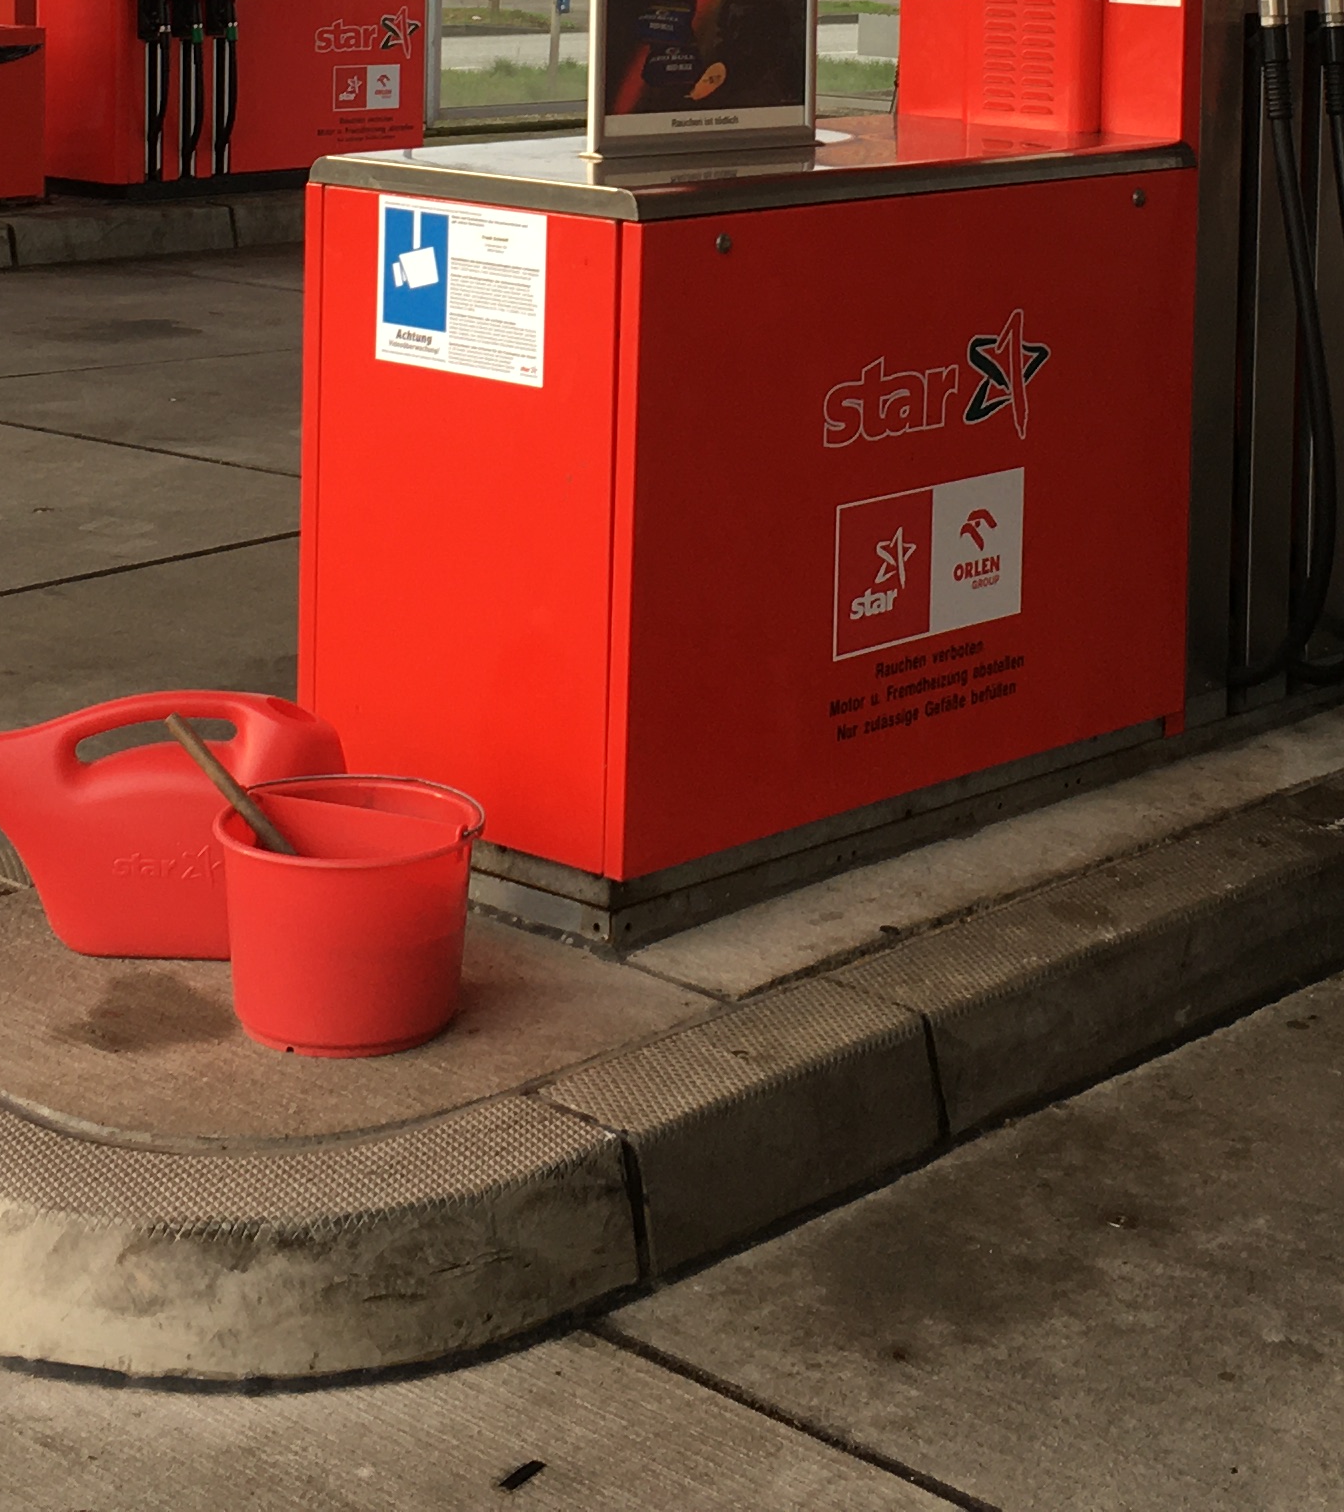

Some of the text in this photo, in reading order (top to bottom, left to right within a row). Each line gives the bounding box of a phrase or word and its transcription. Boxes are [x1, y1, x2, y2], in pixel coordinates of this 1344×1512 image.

[314, 18, 377, 54] star
[671, 119, 704, 128] Rauchen
[395, 329, 433, 345] Achtung
[823, 356, 959, 448] star
[953, 554, 1000, 582] ORLEN
[971, 574, 1000, 590] GROUP
[849, 587, 898, 620] star
[876, 640, 984, 679] Rauchen verboten
[829, 696, 865, 718] Motor
[886, 669, 968, 702] Fremdheizung
[973, 655, 1024, 680] abstellen
[836, 724, 859, 742] Nur
[113, 852, 176, 877] star
